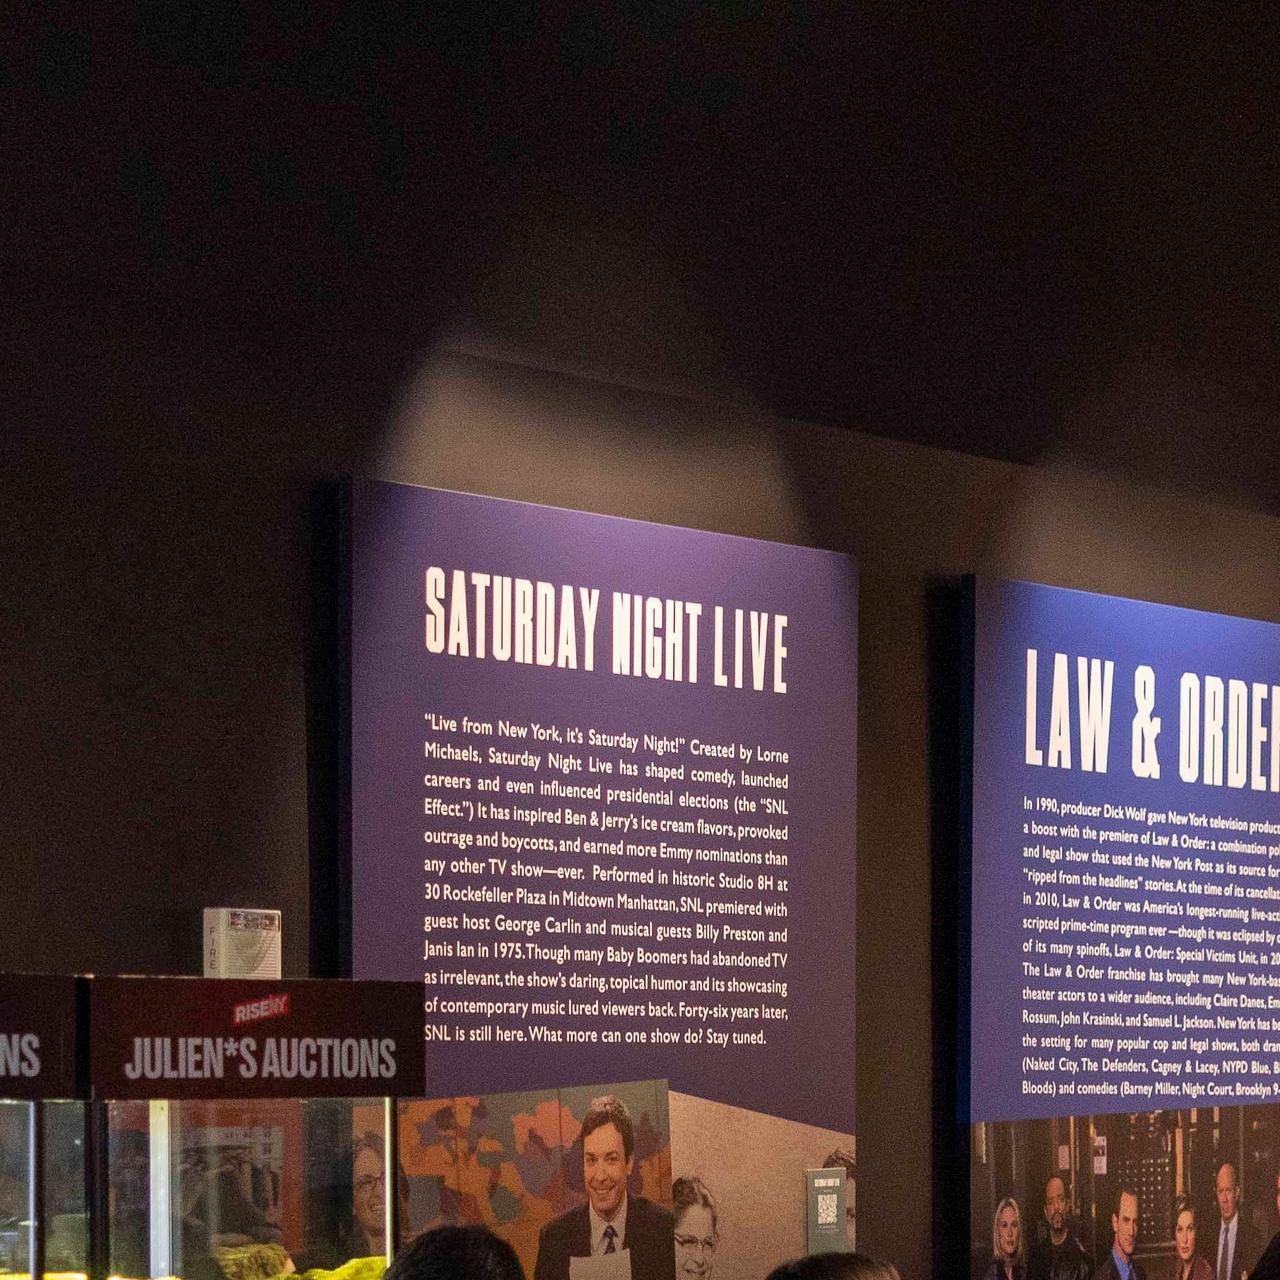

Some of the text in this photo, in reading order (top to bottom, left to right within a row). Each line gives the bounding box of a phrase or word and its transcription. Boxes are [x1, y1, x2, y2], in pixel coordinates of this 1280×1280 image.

[425, 566, 789, 694] SATURDAY NIGHT LIVE
[1025, 648, 1115, 774] LAW
[1131, 665, 1161, 780] &
[424, 713, 789, 764] “Live from New York, it’s Saturday Night!” Created by Lorne
[425, 741, 788, 789] Michaels, Saturday Night Live has shaped comedy, launched
[424, 774, 788, 815] careers and even influenced presidential elections (the “SNL
[1024, 796, 1032, 810] In
[1061, 802, 1102, 817] producer
[1104, 804, 1124, 819] Dick
[1125, 806, 1146, 821] Wolf
[1147, 812, 1166, 826] gave
[1168, 811, 1188, 824] New
[1189, 813, 1208, 827] York
[1210, 816, 1248, 830] television
[425, 798, 788, 841] Effect.”) It has inspired Ben & Jerry’s ice cream flavors, provoked
[1023, 823, 1029, 833] a
[1032, 821, 1057, 836] boost
[1060, 825, 1079, 838] with
[1082, 826, 1097, 839] the
[1099, 830, 1138, 843] premiere
[1141, 831, 1150, 844] of
[1152, 832, 1169, 845] Law
[1211, 841, 1216, 850] a
[1218, 840, 1267, 854] combination
[1023, 892, 1031, 904] in
[1063, 894, 1080, 907] Law
[1094, 896, 1121, 910] Order
[1124, 902, 1140, 912] was
[1143, 900, 1183, 915] America’s
[1186, 903, 1249, 923] longest-running
[208, 926, 217, 970] FIRE
[261, 1038, 397, 1079] AUCTIONS
